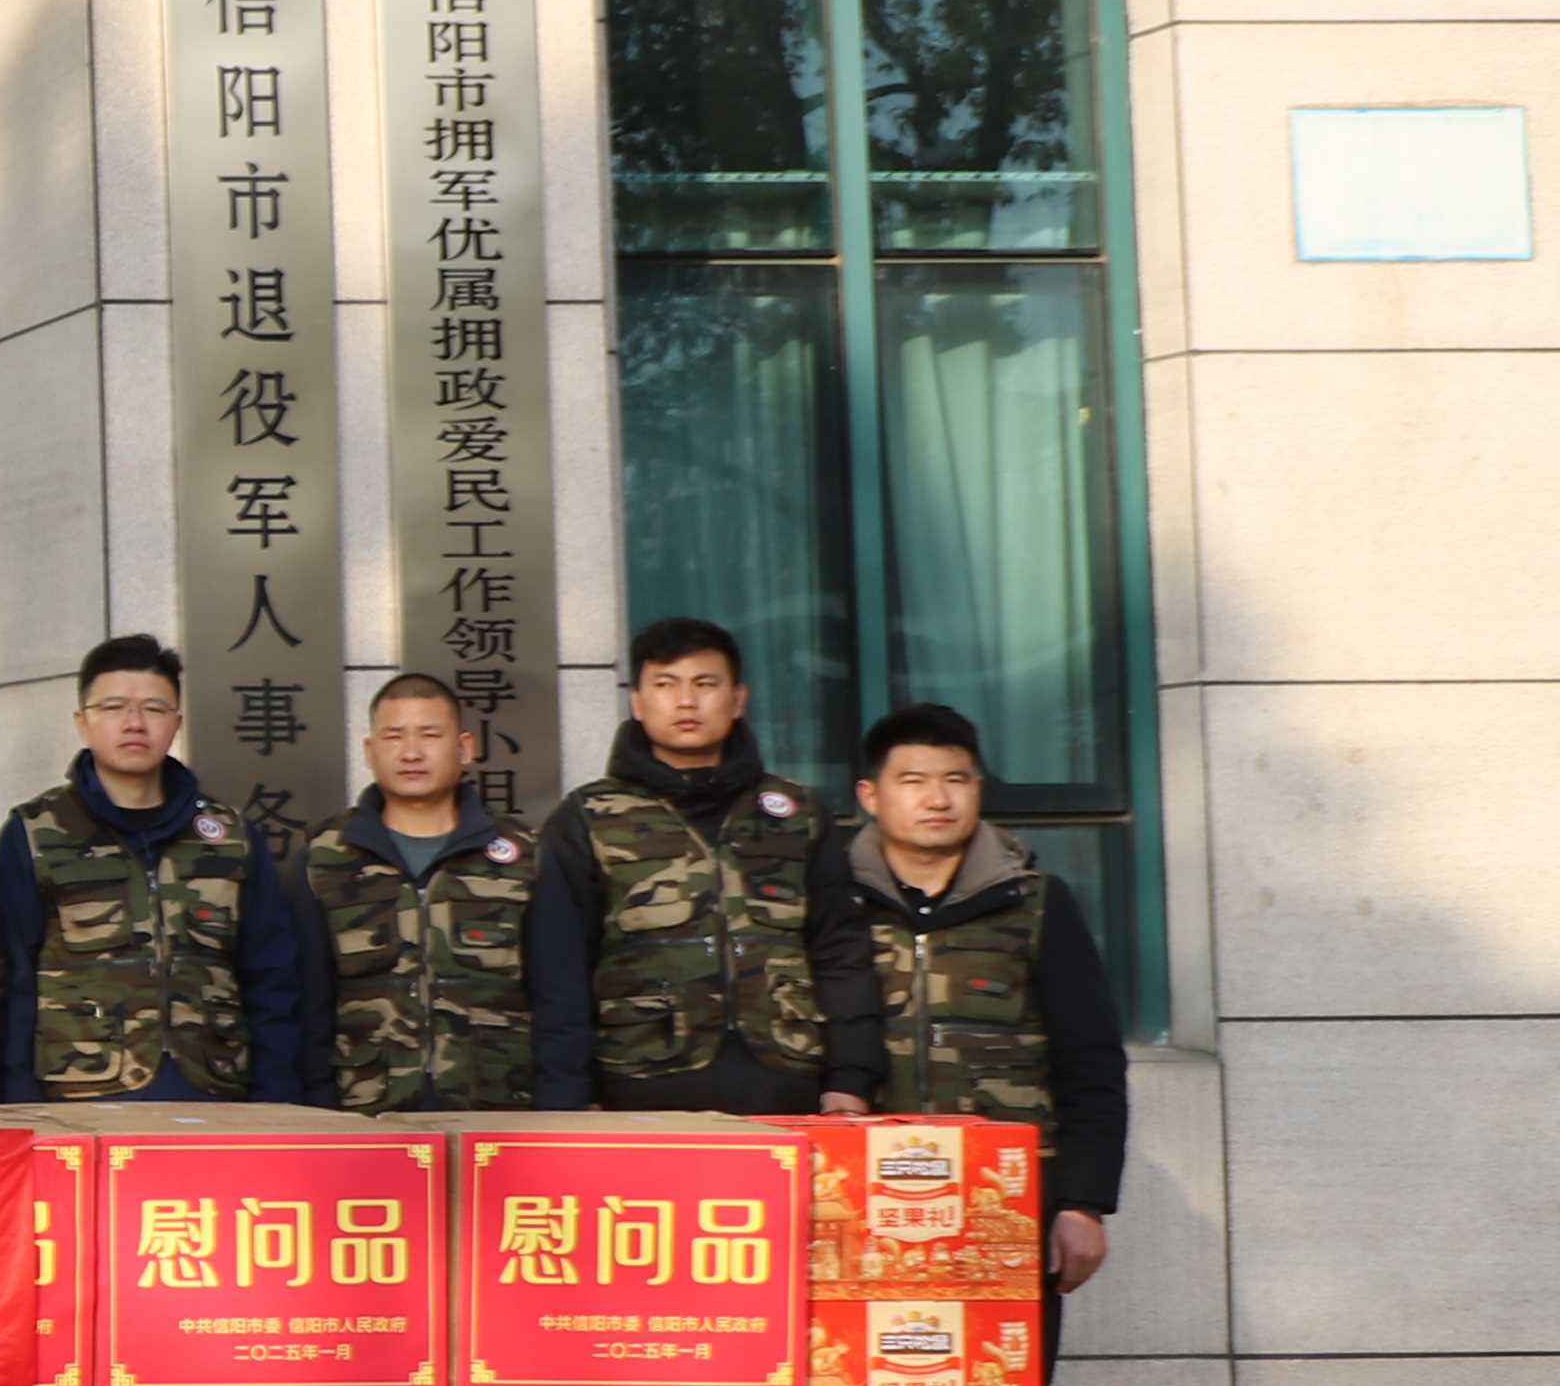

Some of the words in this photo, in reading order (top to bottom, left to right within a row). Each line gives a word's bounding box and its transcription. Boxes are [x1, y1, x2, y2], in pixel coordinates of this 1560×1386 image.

[136, 1196, 409, 1289] 慰问品
[499, 1195, 771, 1286] 慰问品
[178, 1316, 281, 1334] 中共信阳市委
[288, 1315, 407, 1334] 信阳市人民政府
[538, 1314, 641, 1332] 中共信阳市委
[647, 1314, 767, 1333] 信阳市人民政府
